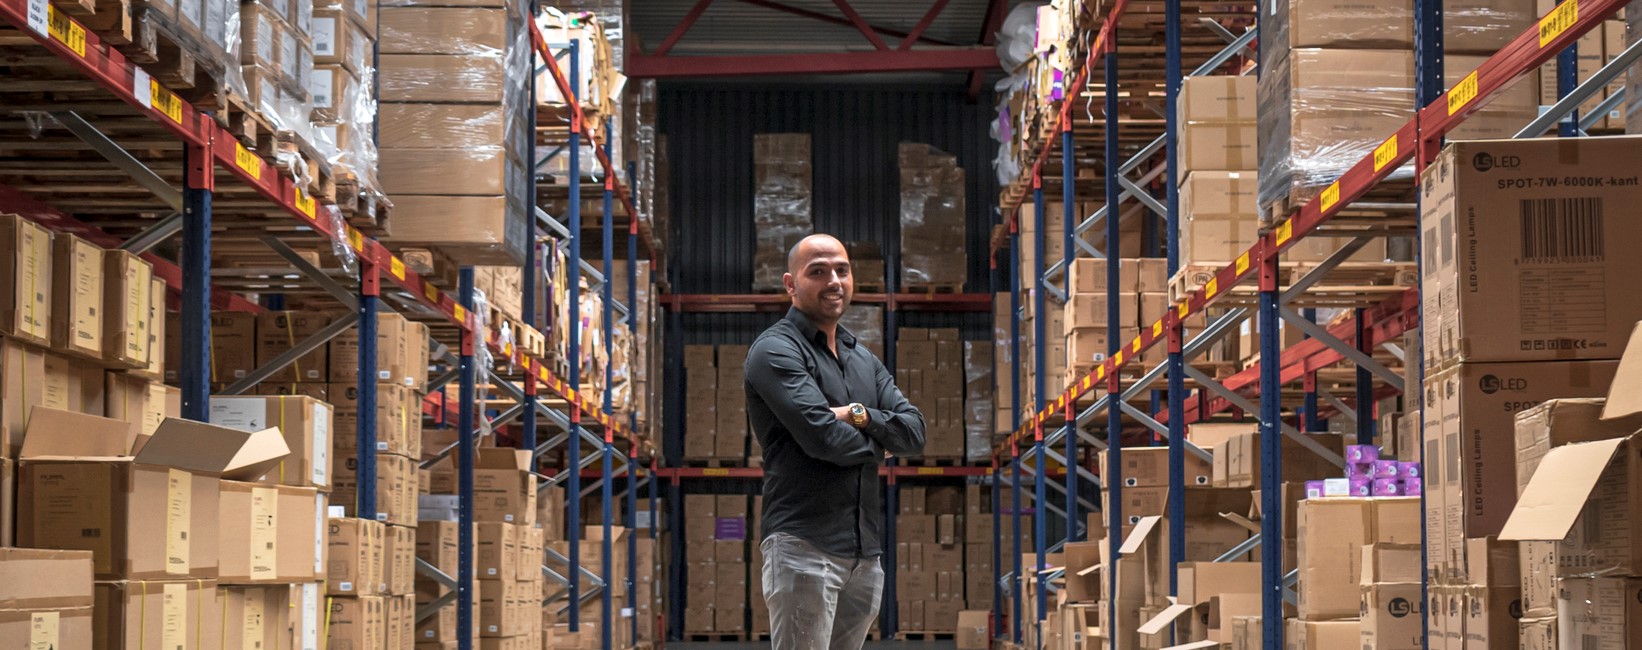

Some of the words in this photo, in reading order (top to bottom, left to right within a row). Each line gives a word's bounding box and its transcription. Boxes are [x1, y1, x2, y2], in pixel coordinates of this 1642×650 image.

[1468, 207, 1476, 237] Lamps
[1469, 239, 1477, 272] Ceiling
[1474, 429, 1482, 460] Lamps
[1474, 462, 1483, 494] Ceiling
